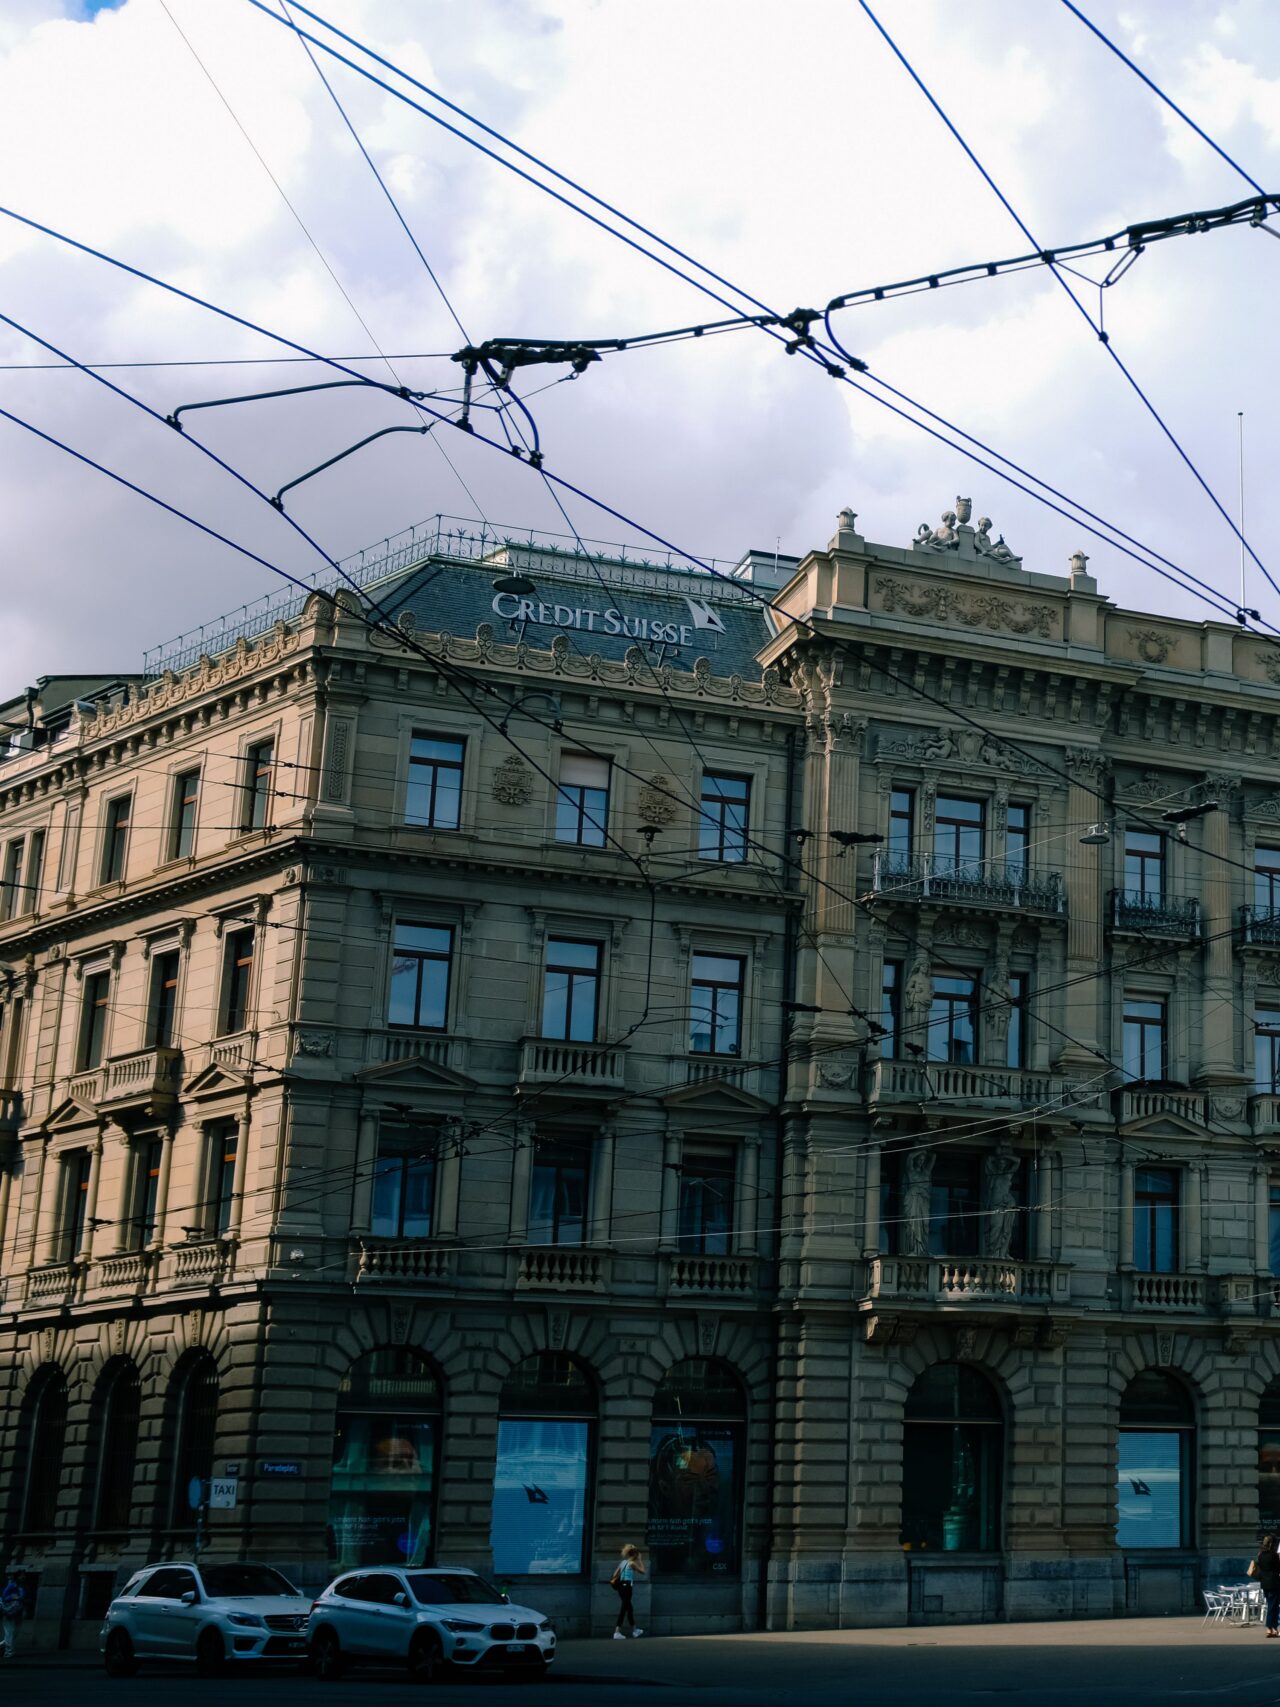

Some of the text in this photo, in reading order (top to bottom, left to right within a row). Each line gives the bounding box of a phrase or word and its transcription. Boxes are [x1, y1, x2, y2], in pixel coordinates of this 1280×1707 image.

[492, 592, 693, 647] CREDIT SUISSE
[214, 1485, 235, 1495] TAXI
